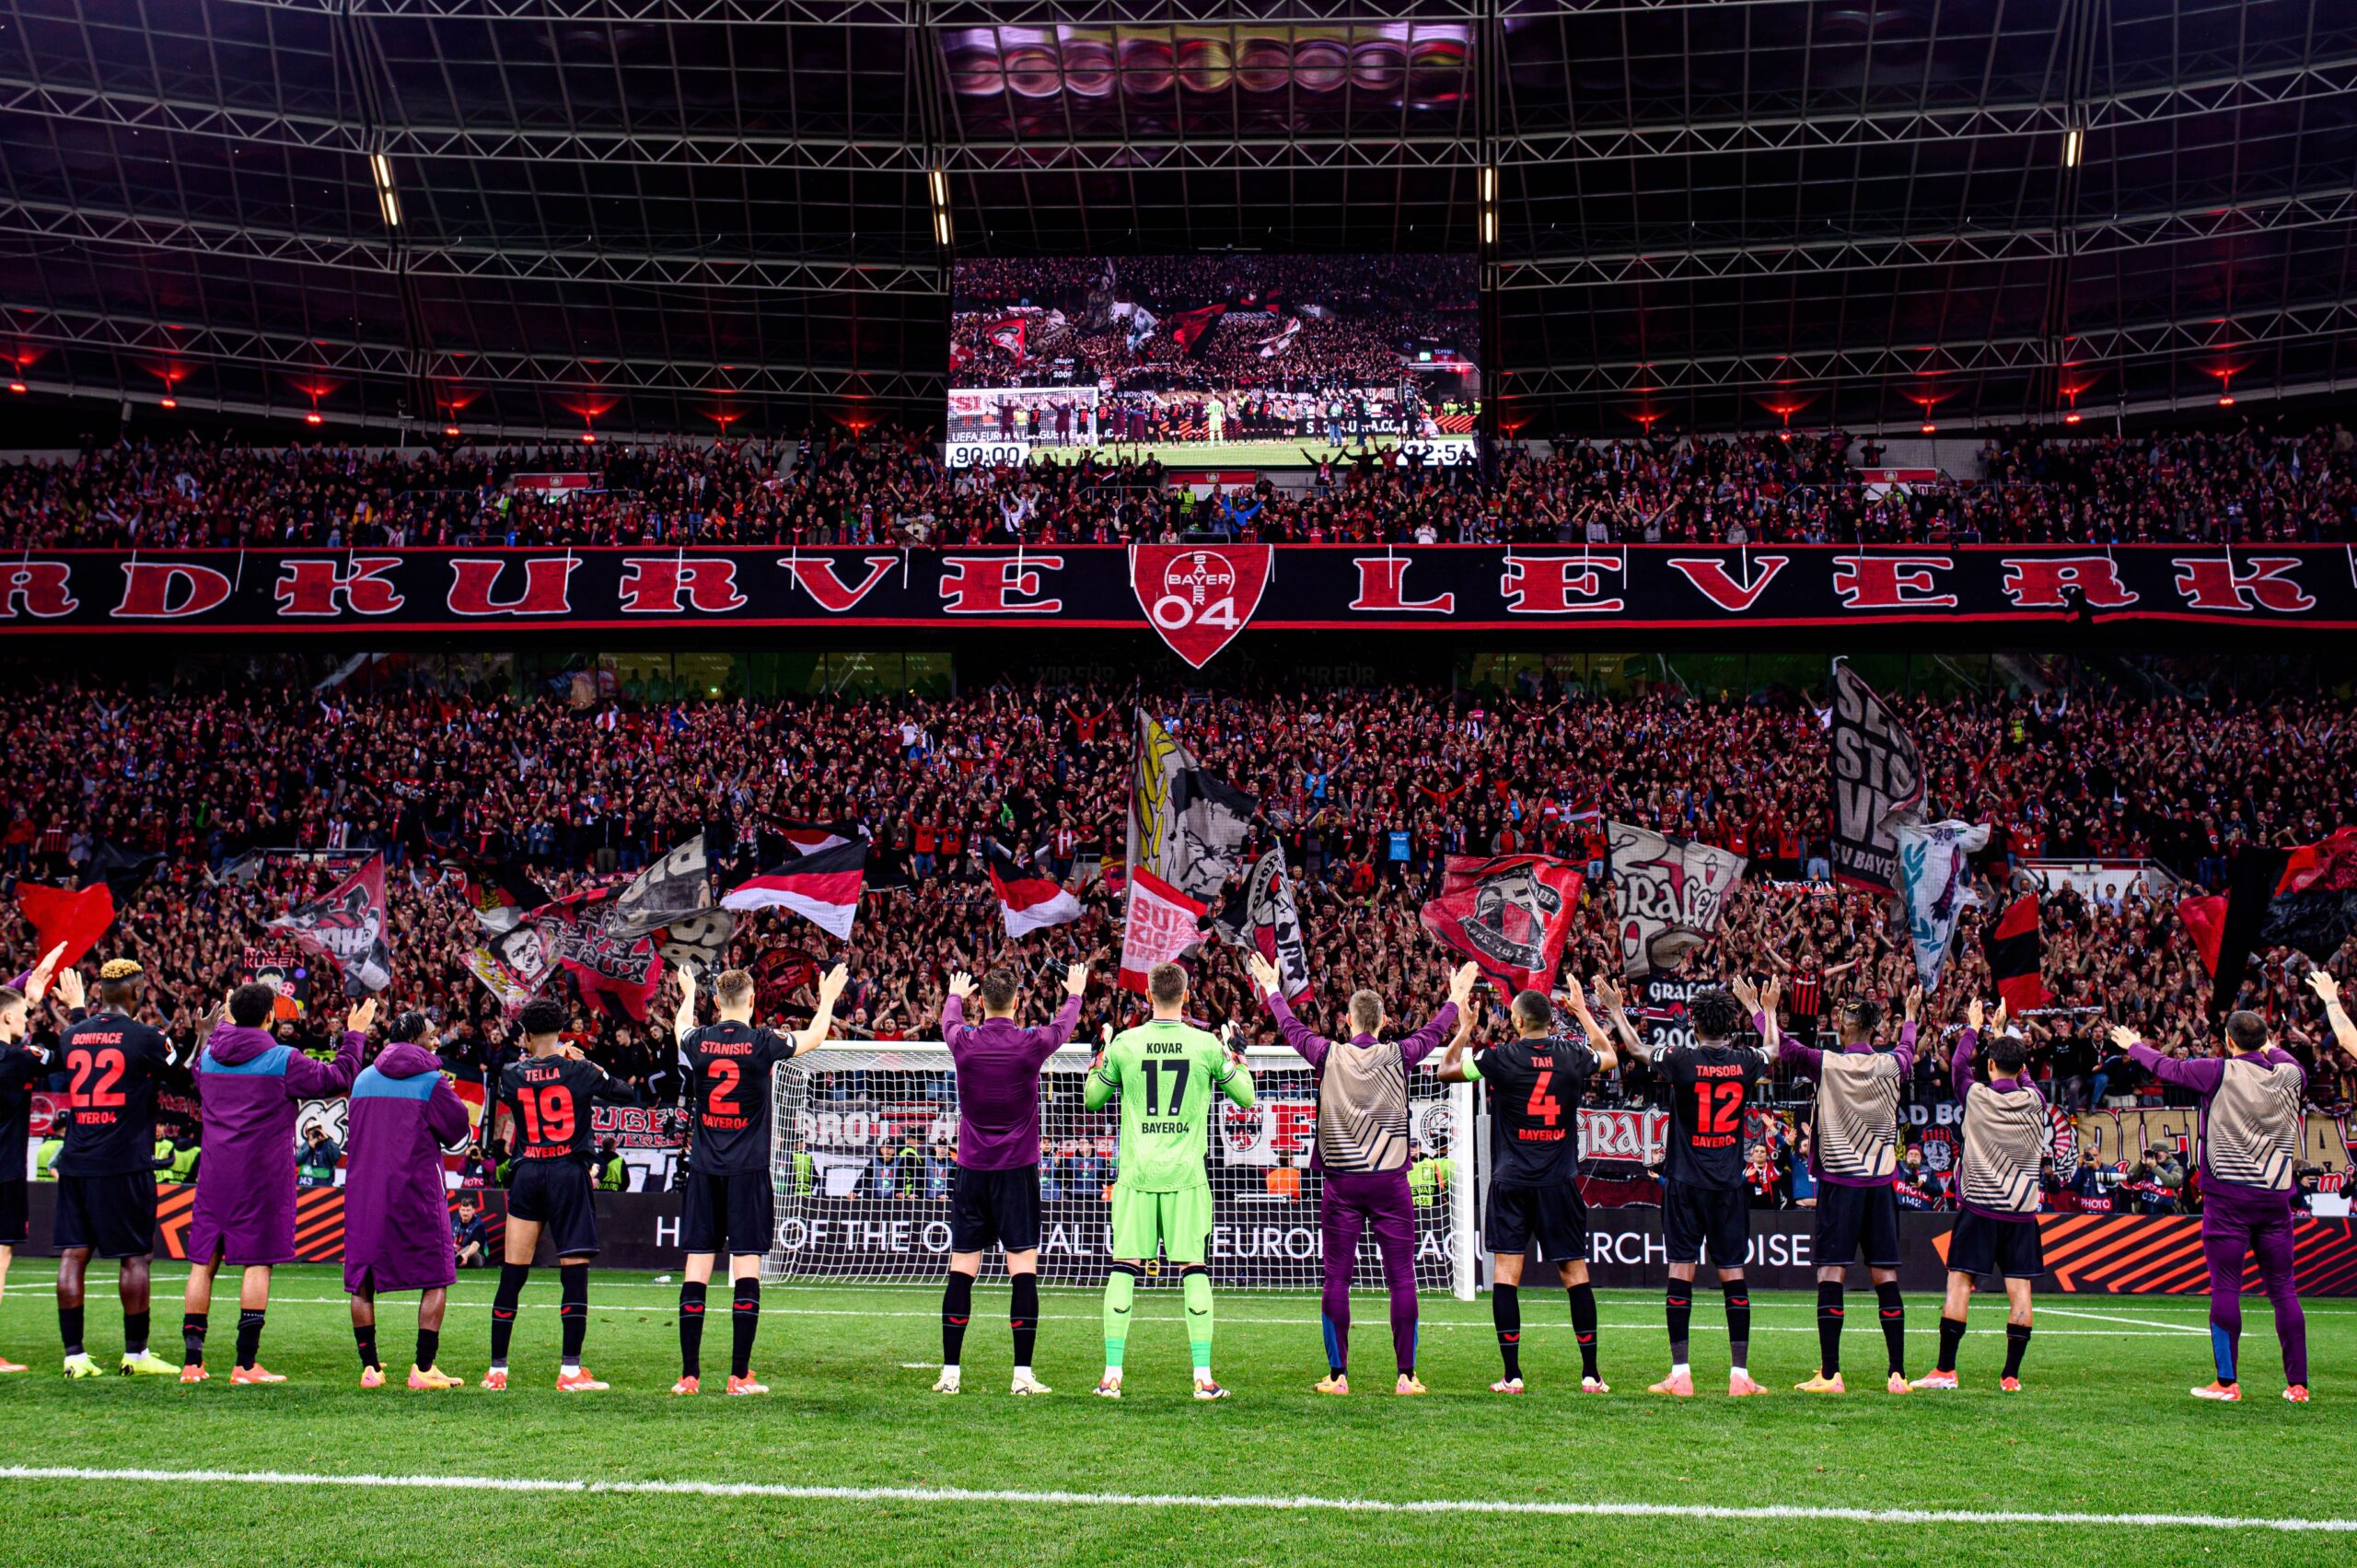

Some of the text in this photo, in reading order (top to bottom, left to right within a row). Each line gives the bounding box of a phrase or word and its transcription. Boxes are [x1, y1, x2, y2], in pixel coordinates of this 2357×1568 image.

[1168, 574, 1231, 585] BAYER
[1153, 595, 1240, 631] 04
[244, 956, 305, 969] KUSEN
[72, 1032, 123, 1045] BONIFACE
[700, 1040, 753, 1055] STANISIC
[1146, 1042, 1183, 1054] KOVAR
[1531, 1056, 1553, 1068] TAH
[525, 1067, 561, 1082] TELLA
[1695, 1063, 1744, 1077] TAPSOBA
[66, 1048, 126, 1108] 22
[707, 1058, 740, 1116] 2
[1141, 1059, 1190, 1117] 17
[1527, 1071, 1561, 1126] 4
[517, 1085, 575, 1144] 19
[1694, 1081, 1744, 1133] 12
[2081, 1199, 2110, 1210] PHOTO
[778, 1218, 829, 1249] OF
[841, 1220, 911, 1251] THE
